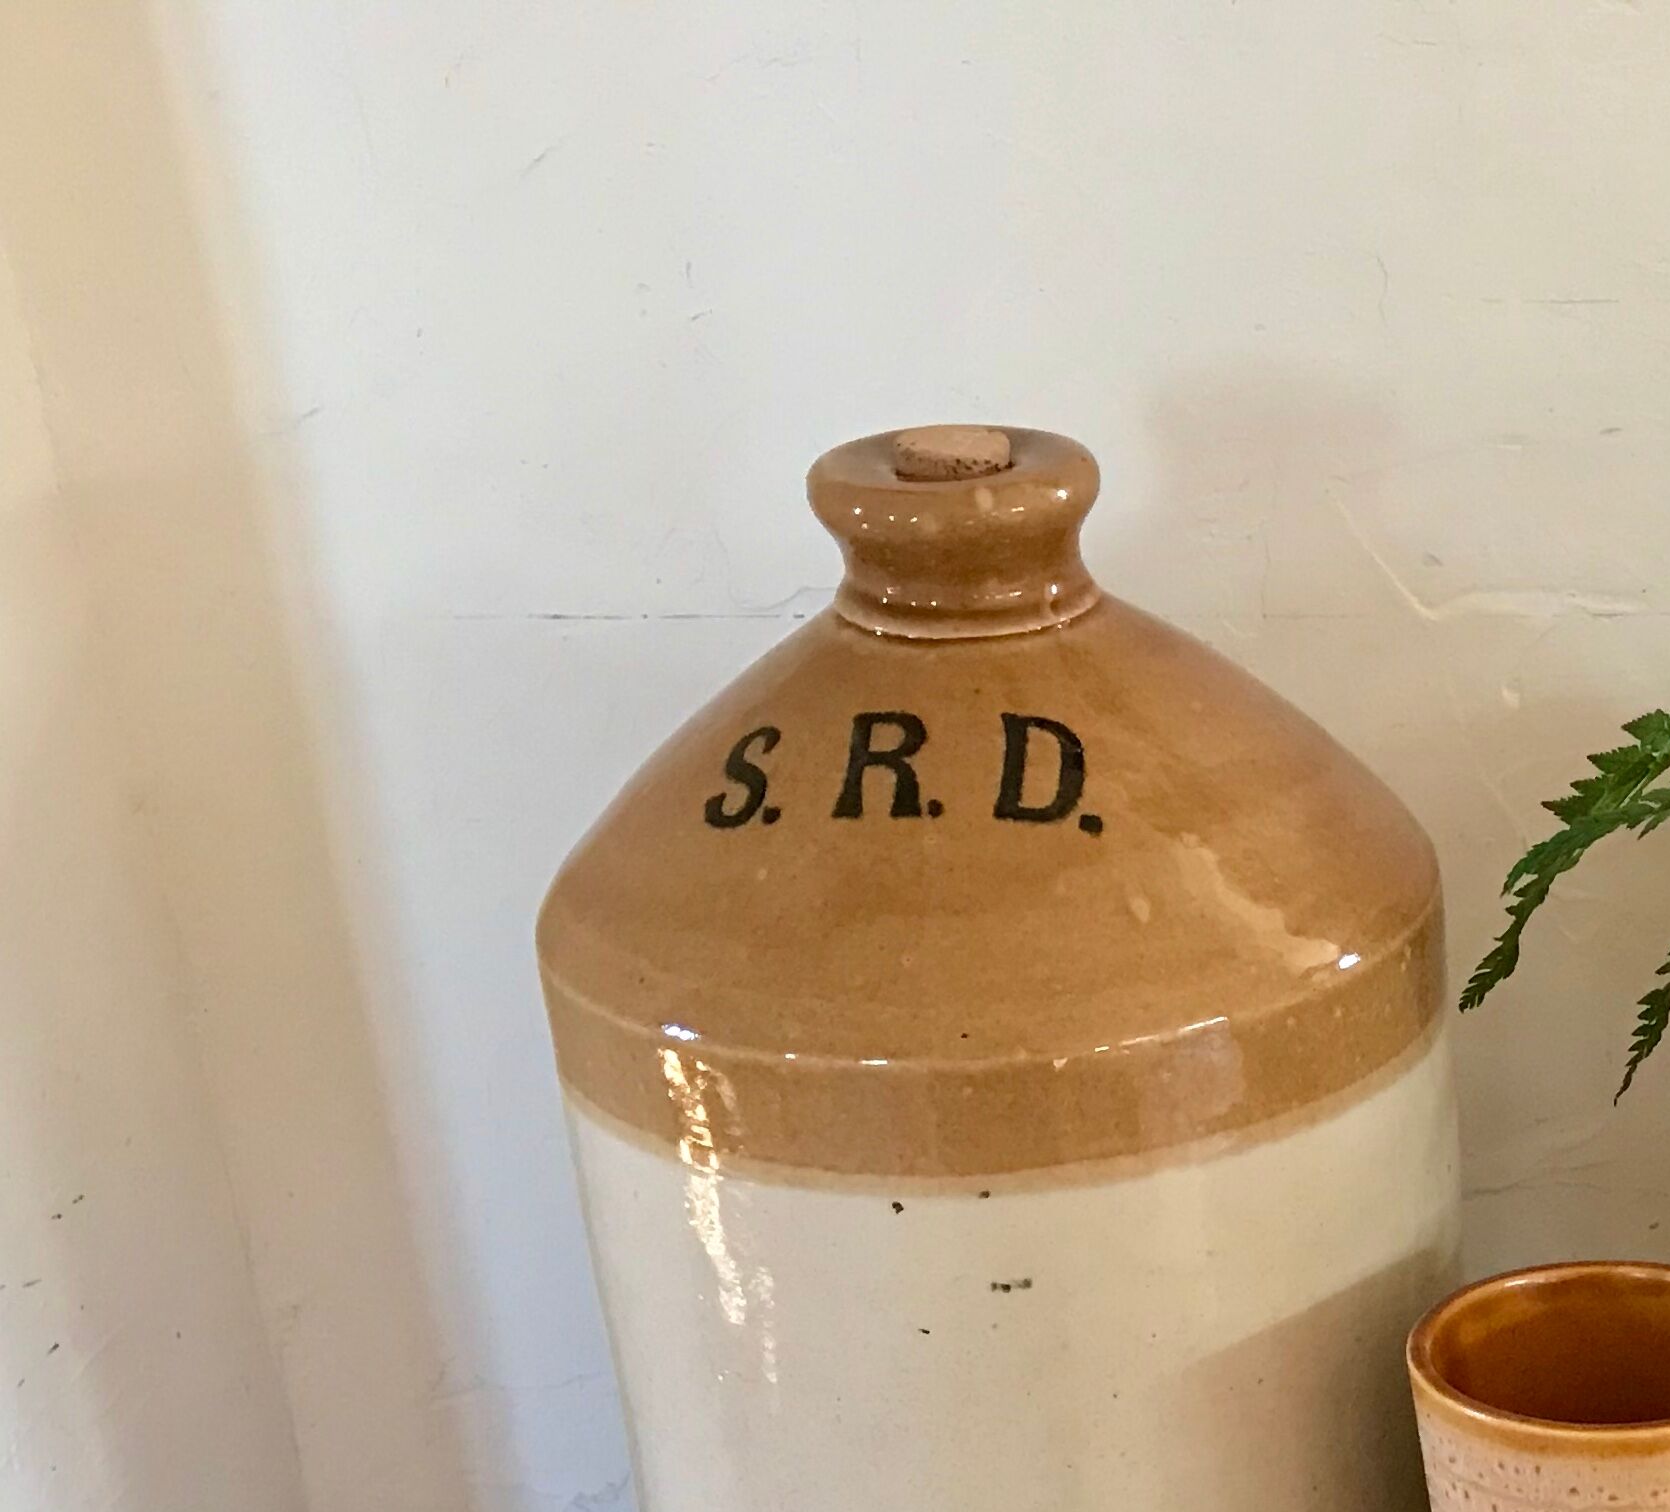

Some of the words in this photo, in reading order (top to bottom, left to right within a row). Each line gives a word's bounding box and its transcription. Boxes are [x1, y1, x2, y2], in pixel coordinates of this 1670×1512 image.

[704, 726, 783, 830] S.
[831, 710, 945, 820] R.
[993, 711, 1104, 837] D.
